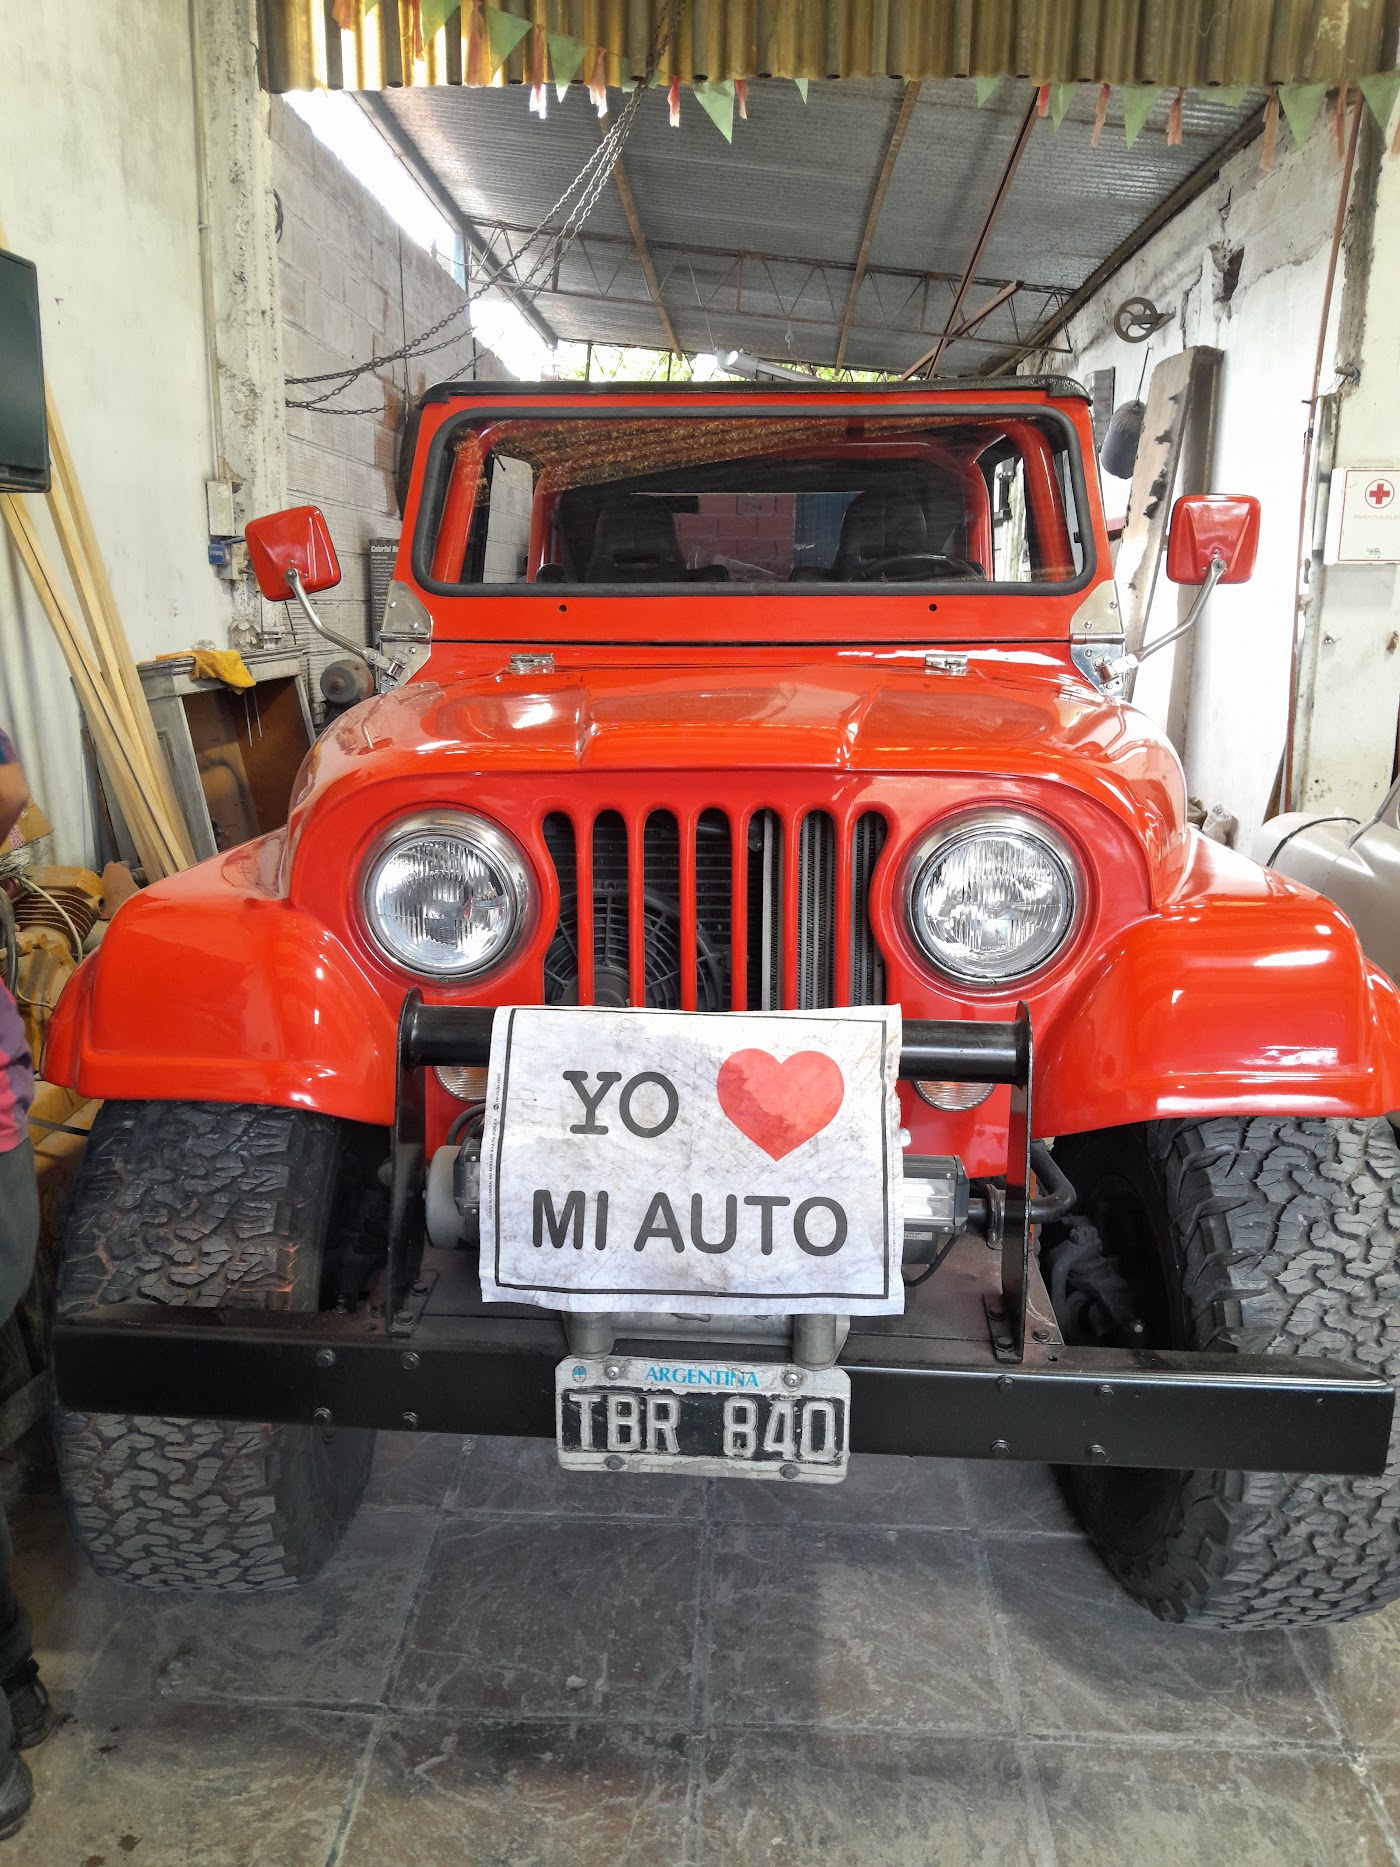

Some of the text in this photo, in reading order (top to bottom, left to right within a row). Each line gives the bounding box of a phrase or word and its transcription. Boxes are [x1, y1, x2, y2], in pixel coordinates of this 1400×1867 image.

[562, 1070, 680, 1139] YO
[532, 1189, 849, 1256] MI AUTO
[645, 1366, 759, 1388] ARGENTINA
[569, 1393, 836, 1461] TBR 840
